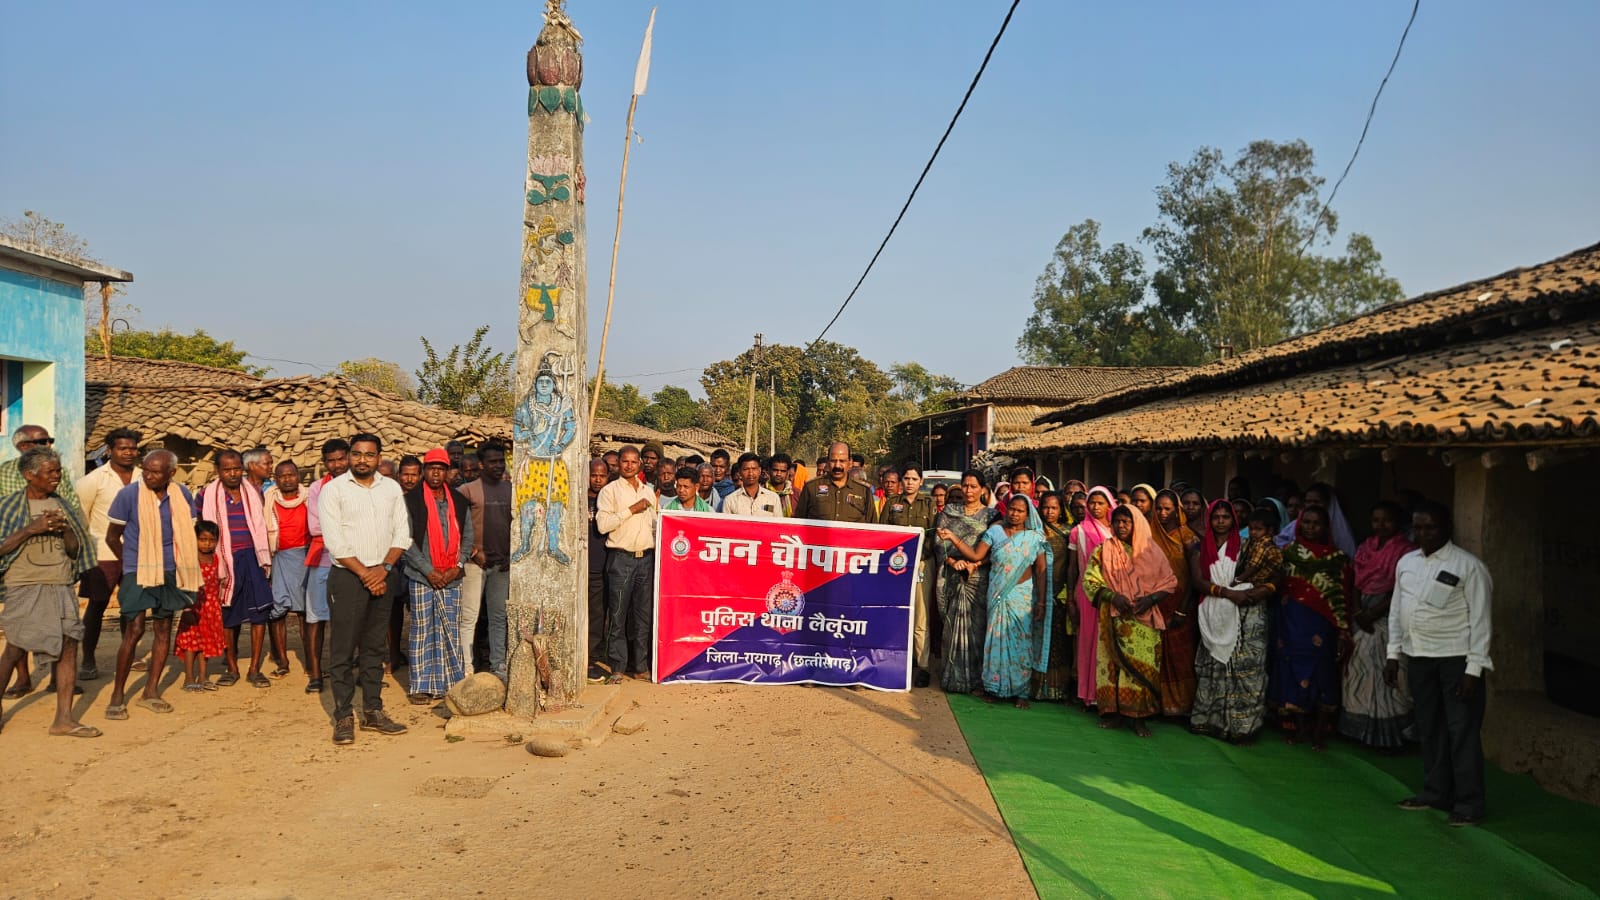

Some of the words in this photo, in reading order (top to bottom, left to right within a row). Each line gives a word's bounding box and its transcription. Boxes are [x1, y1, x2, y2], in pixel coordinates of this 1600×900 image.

[698, 536, 762, 566] जन
[770, 534, 884, 574] चौपाल
[701, 606, 755, 633] पुलिस
[760, 612, 803, 631] थाना
[808, 612, 867, 638] लैलूंगा
[706, 647, 782, 667] जिला-रायगढ़
